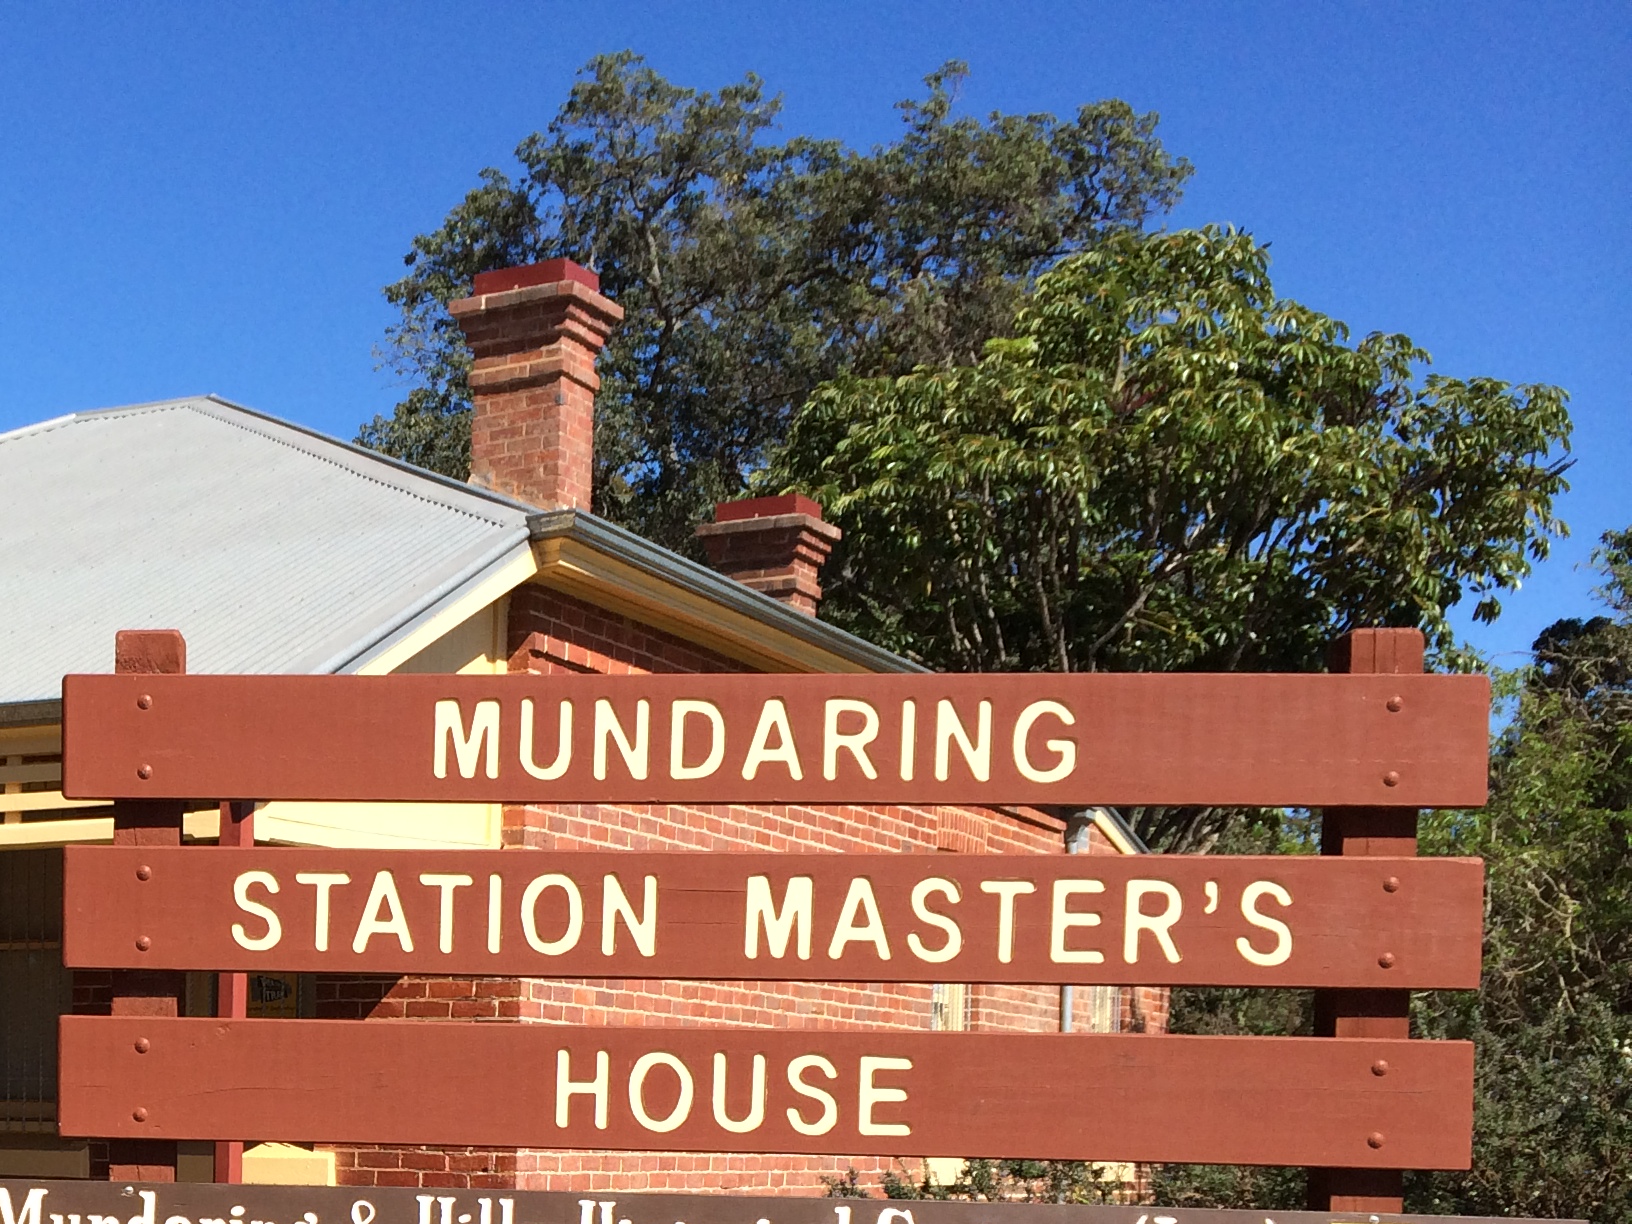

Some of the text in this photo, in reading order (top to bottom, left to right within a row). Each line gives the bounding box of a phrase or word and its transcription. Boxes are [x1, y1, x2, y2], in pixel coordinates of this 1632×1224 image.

[432, 697, 1078, 785] MUNDARING
[230, 869, 1294, 968] STATION MASTER'S
[554, 1048, 914, 1138] HOUSE
